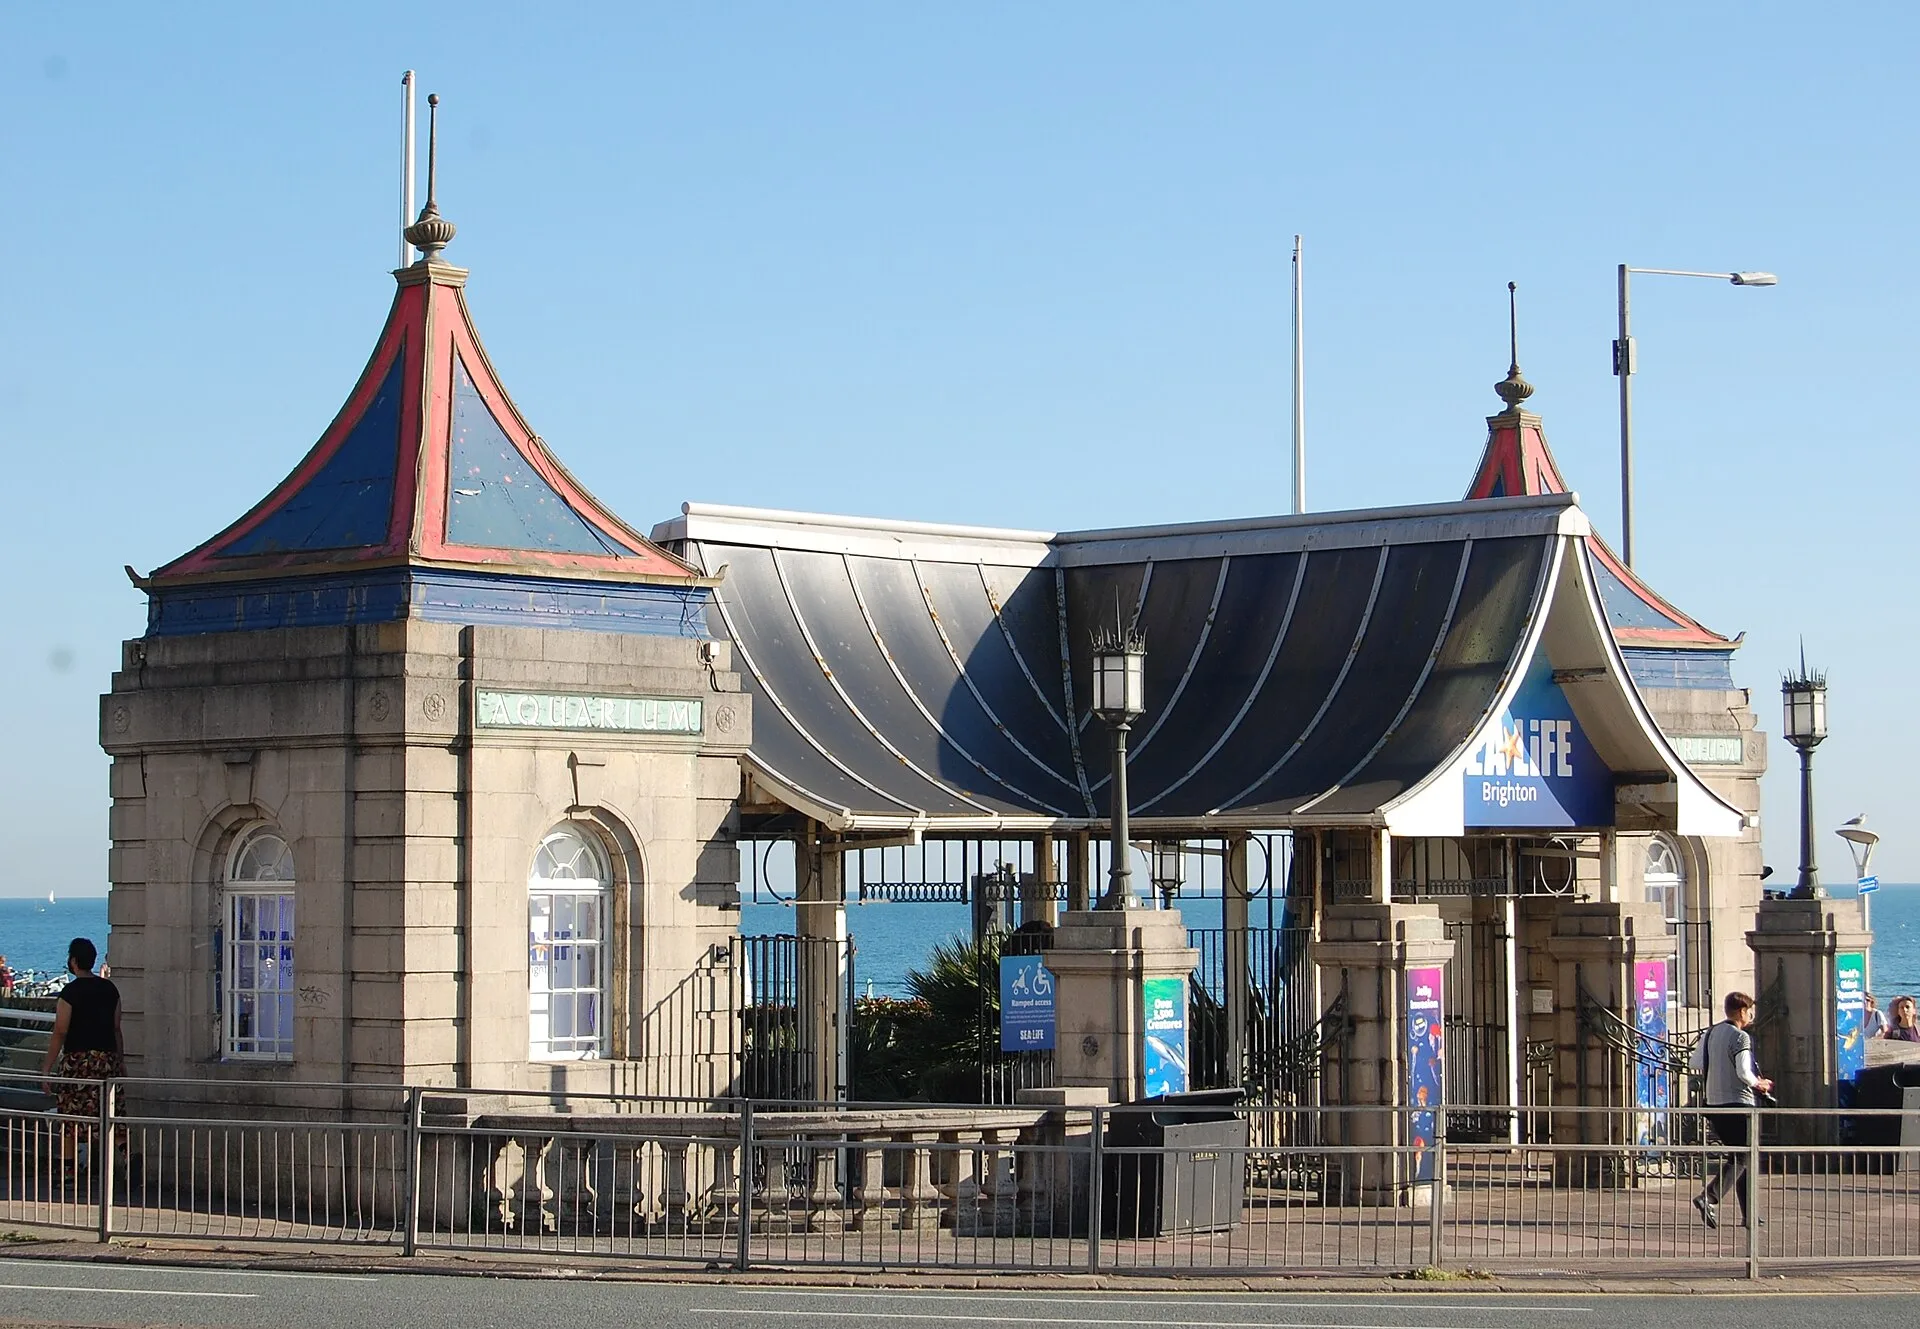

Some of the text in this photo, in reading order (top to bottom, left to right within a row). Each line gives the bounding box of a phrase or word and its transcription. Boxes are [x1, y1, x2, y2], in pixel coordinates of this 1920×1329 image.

[489, 694, 691, 731] AQUARIUM
[1482, 781, 1537, 807] Brighton
[1416, 985, 1433, 998] Jelly
[1011, 999, 1034, 1008] Ramped
[1154, 998, 1173, 1009] Over
[1146, 1019, 1183, 1030] Creatures
[1020, 1030, 1032, 1040] SEA
